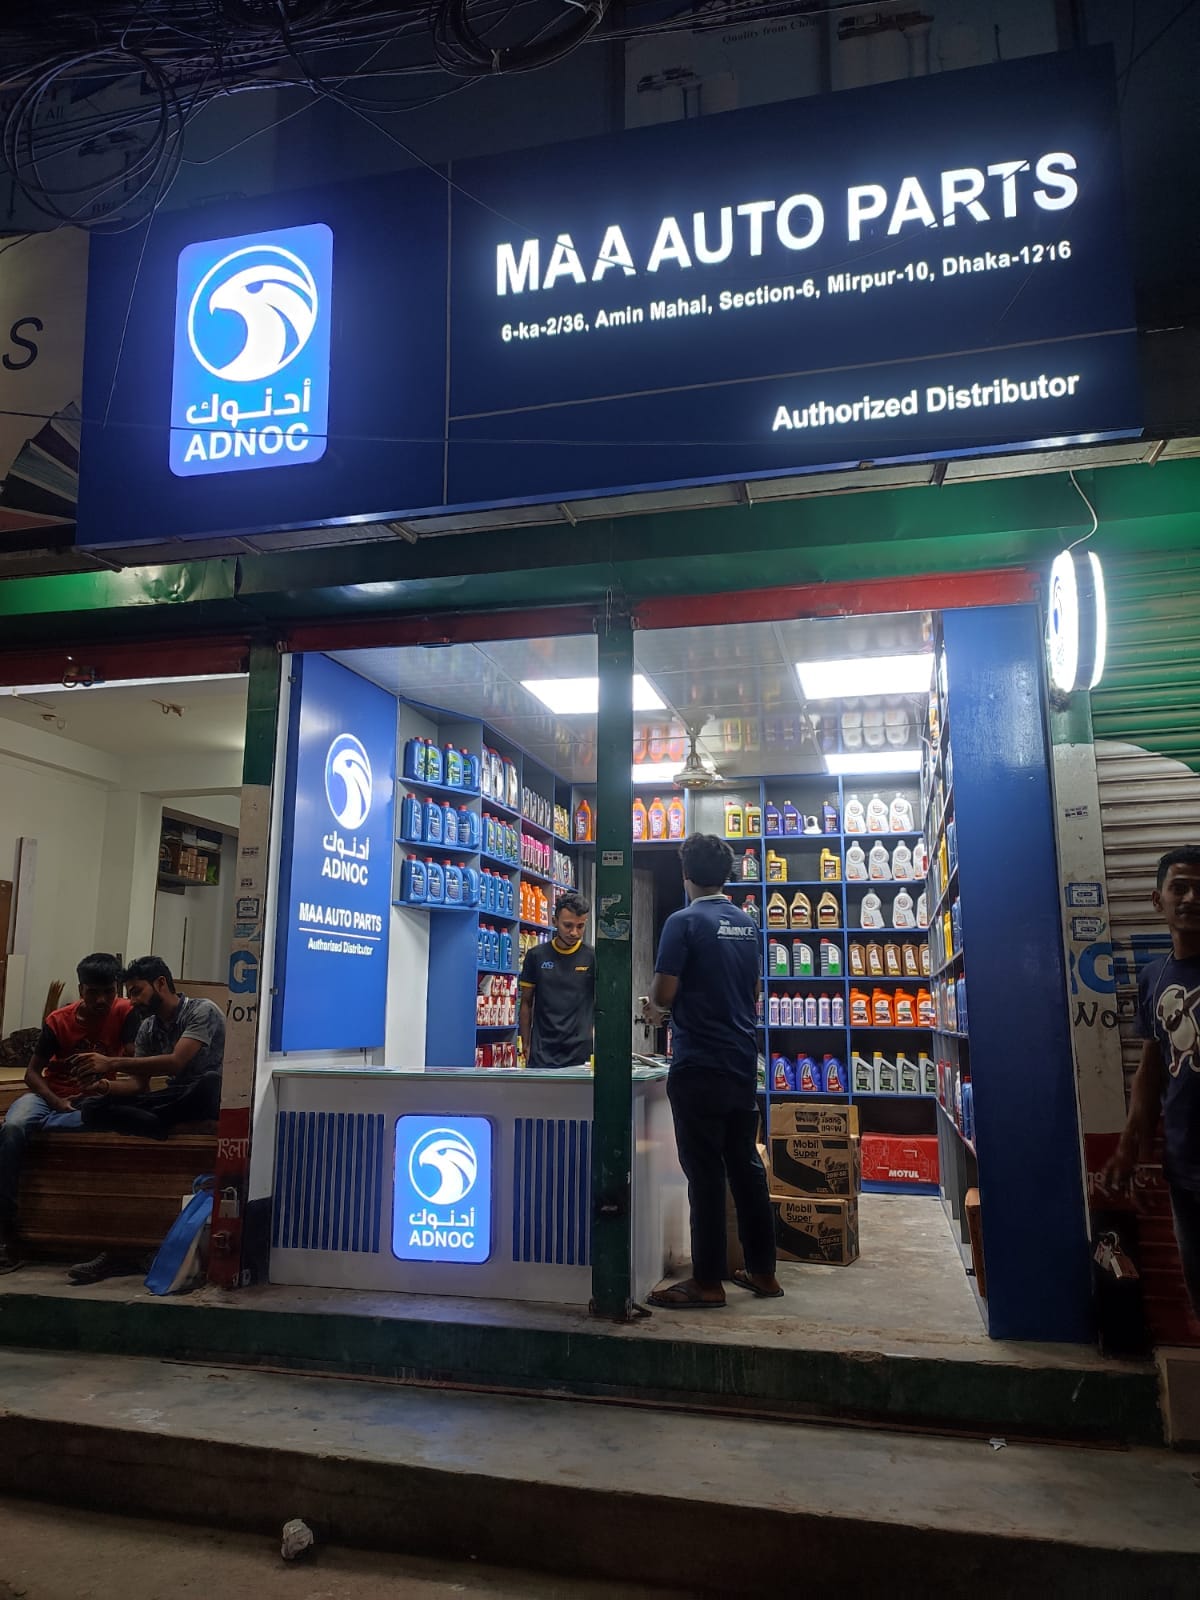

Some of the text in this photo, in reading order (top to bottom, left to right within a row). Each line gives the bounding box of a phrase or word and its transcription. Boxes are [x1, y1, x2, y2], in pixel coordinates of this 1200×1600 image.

[496, 152, 1078, 296] MAA AUTO PARTS
[501, 240, 1072, 342] 6-ka-2/36, Amin Mahal, Section-6, Mirpur-10, Dhaka-1216
[771, 374, 1080, 432] Authorized Distributor
[183, 421, 310, 463] ADNOC
[321, 857, 368, 886] ADNOC
[298, 902, 382, 932] MAA AUTO PARTS
[793, 1139, 819, 1149] Mobil
[794, 1149, 819, 1160] Super
[889, 1169, 919, 1179] MOTUL
[786, 1202, 812, 1213] Mobil
[408, 1229, 474, 1249] ADNOC
